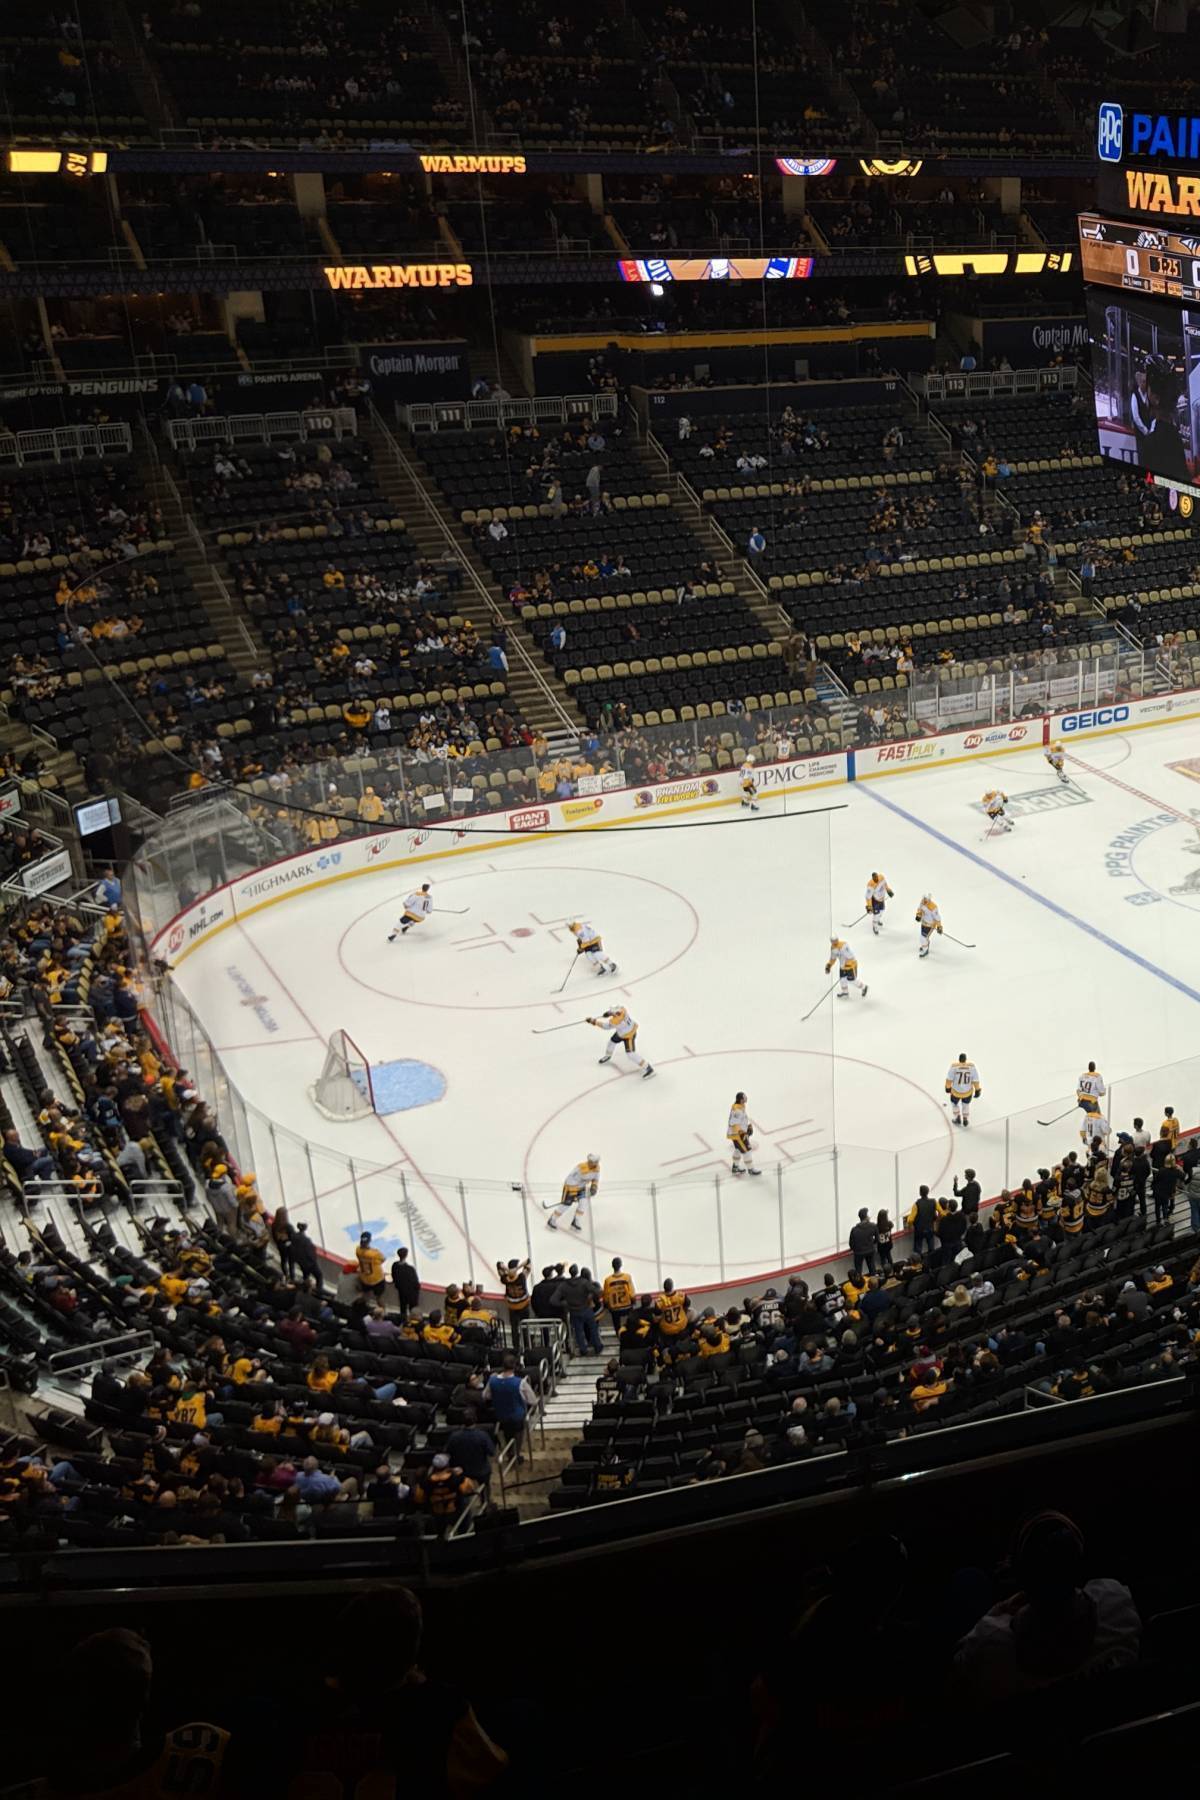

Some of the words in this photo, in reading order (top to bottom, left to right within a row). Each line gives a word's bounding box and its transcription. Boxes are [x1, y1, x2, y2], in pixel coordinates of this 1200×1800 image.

[1099, 110, 1121, 154] PPG
[420, 155, 527, 174] WARMUPS
[1125, 249, 1139, 276] 0
[1158, 257, 1179, 276] 1:25
[325, 264, 473, 289] WARMUPS
[1032, 323, 1071, 350] Captain
[370, 354, 413, 376] Captain
[414, 354, 459, 375] Morgan
[68, 379, 160, 396] PENGUINS
[948, 381, 965, 391] 113
[1043, 375, 1058, 385] 113
[440, 409, 461, 421] 111
[571, 402, 589, 414] 111
[308, 417, 333, 429] 110
[1061, 705, 1130, 732] GEICO
[656, 781, 700, 798] PHANTOM
[513, 811, 546, 823] GIANT
[514, 818, 546, 830] EAGLE
[1110, 814, 1169, 852] PAINTS
[1104, 851, 1132, 878] PPG
[247, 862, 315, 897] HIGHMARK
[956, 1071, 971, 1085] 76
[664, 1306, 681, 1323] 87
